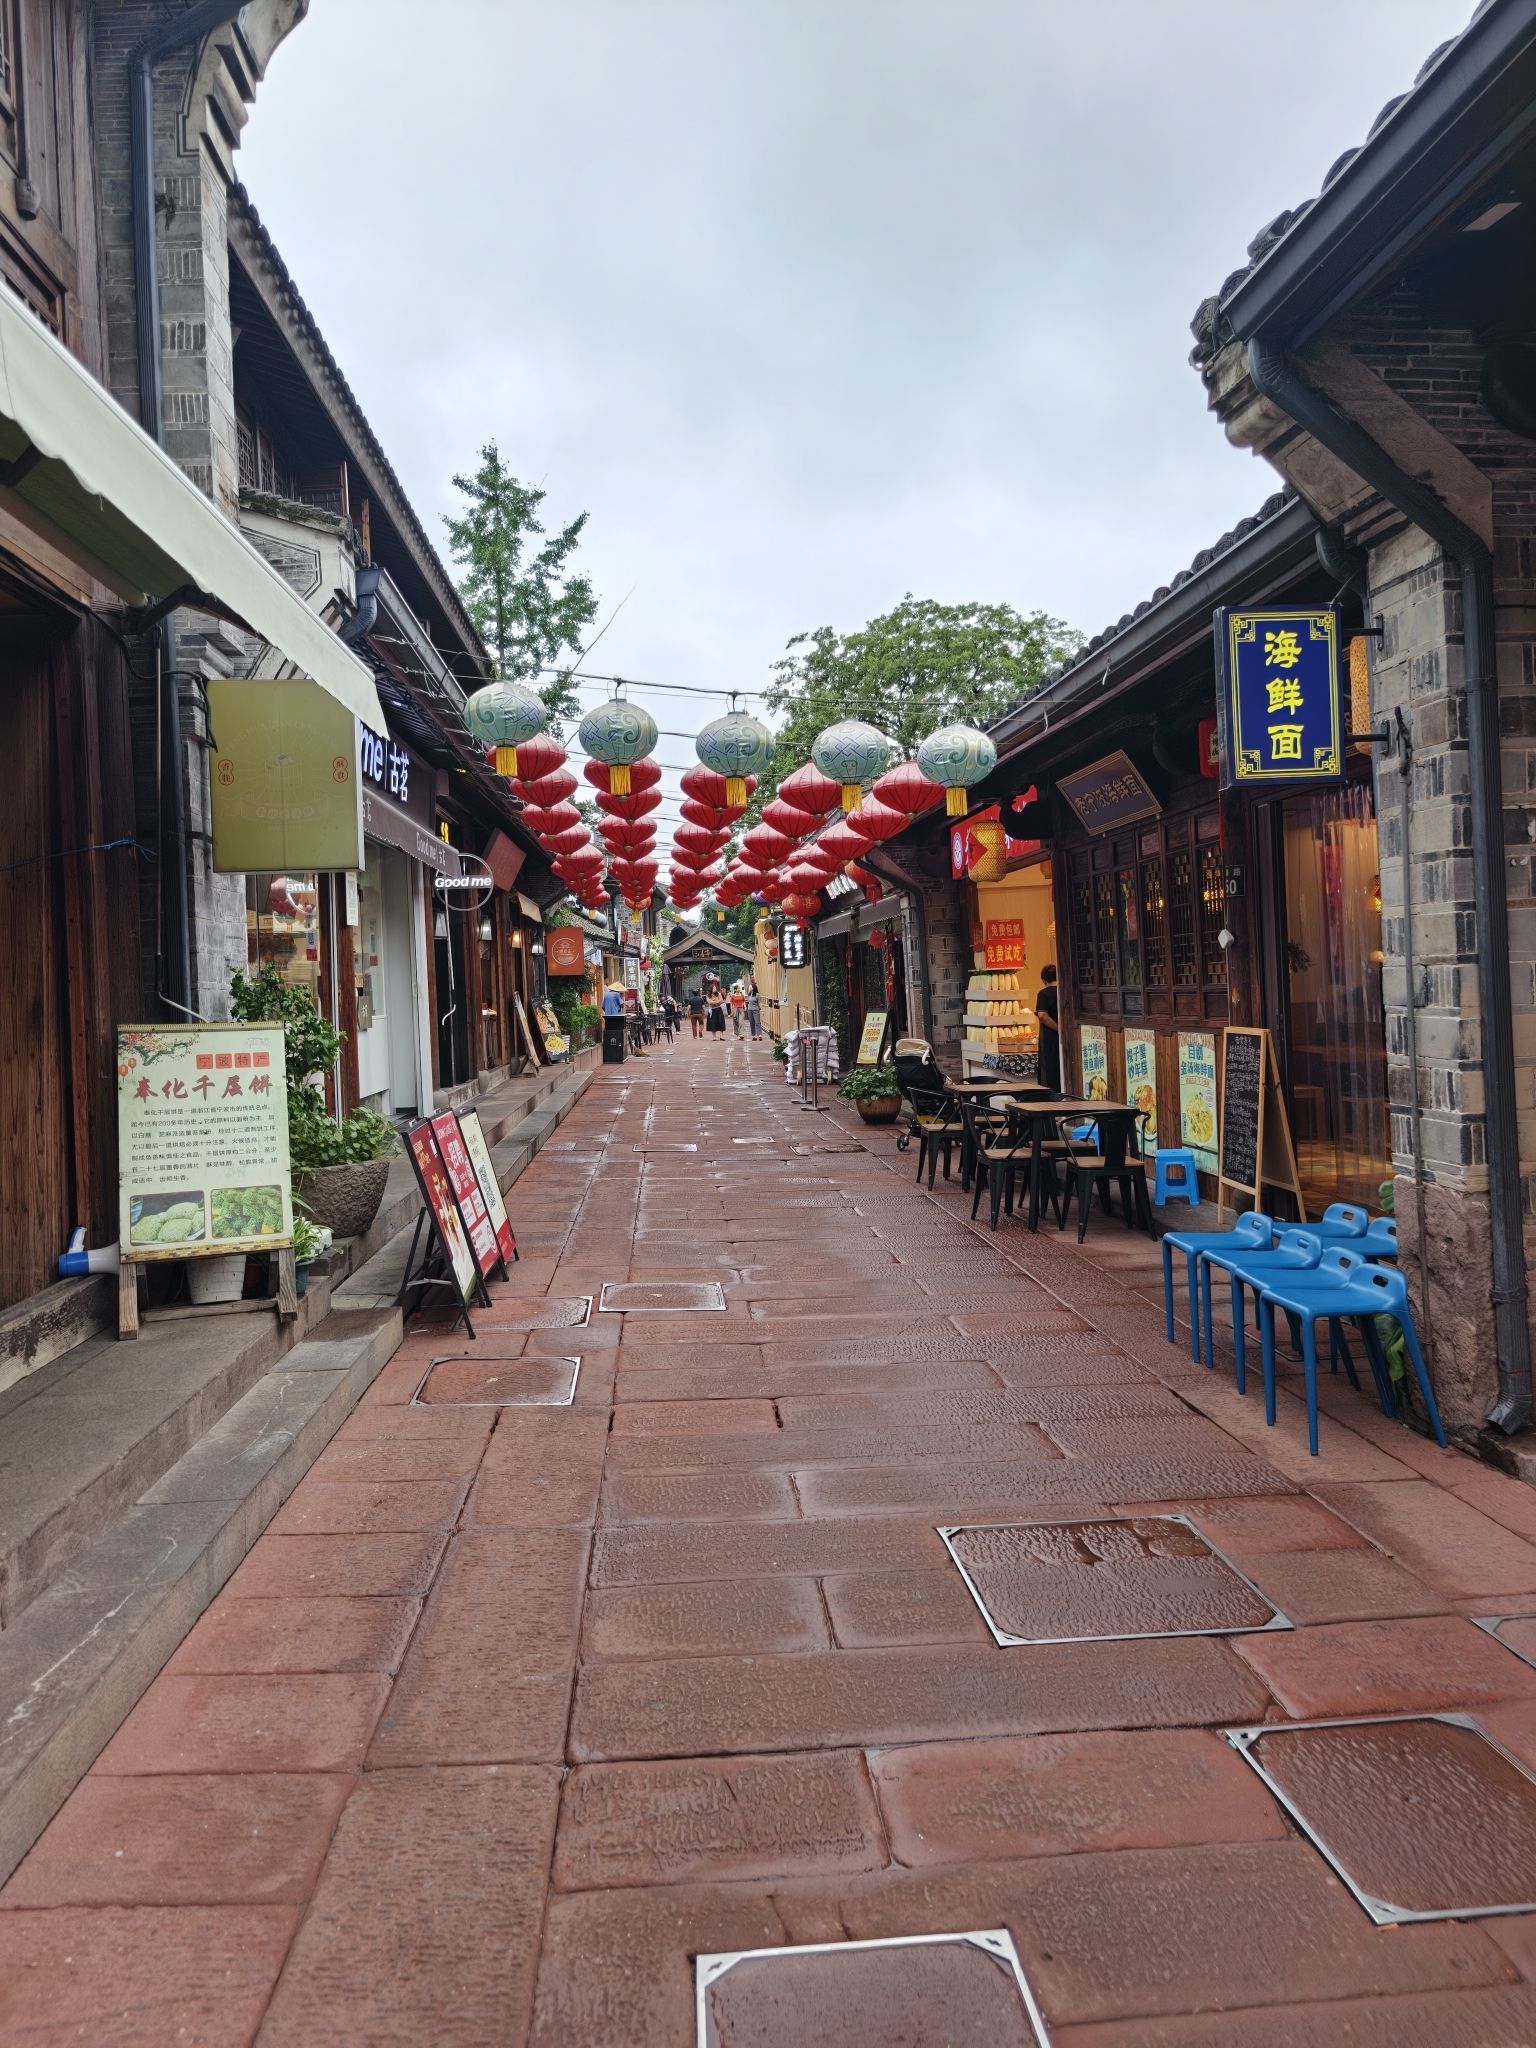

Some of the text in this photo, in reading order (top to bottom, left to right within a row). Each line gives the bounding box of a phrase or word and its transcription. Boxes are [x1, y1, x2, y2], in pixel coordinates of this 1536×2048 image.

[1264, 630, 1304, 760] 海鲜面
[389, 742, 410, 802] 古茗
[435, 876, 492, 888] Good me
[991, 923, 1021, 937] 免费包邮
[987, 944, 1022, 963] 免费试吃
[199, 1053, 268, 1067] 宁波特产
[133, 1073, 273, 1104] 奉化千层饼
